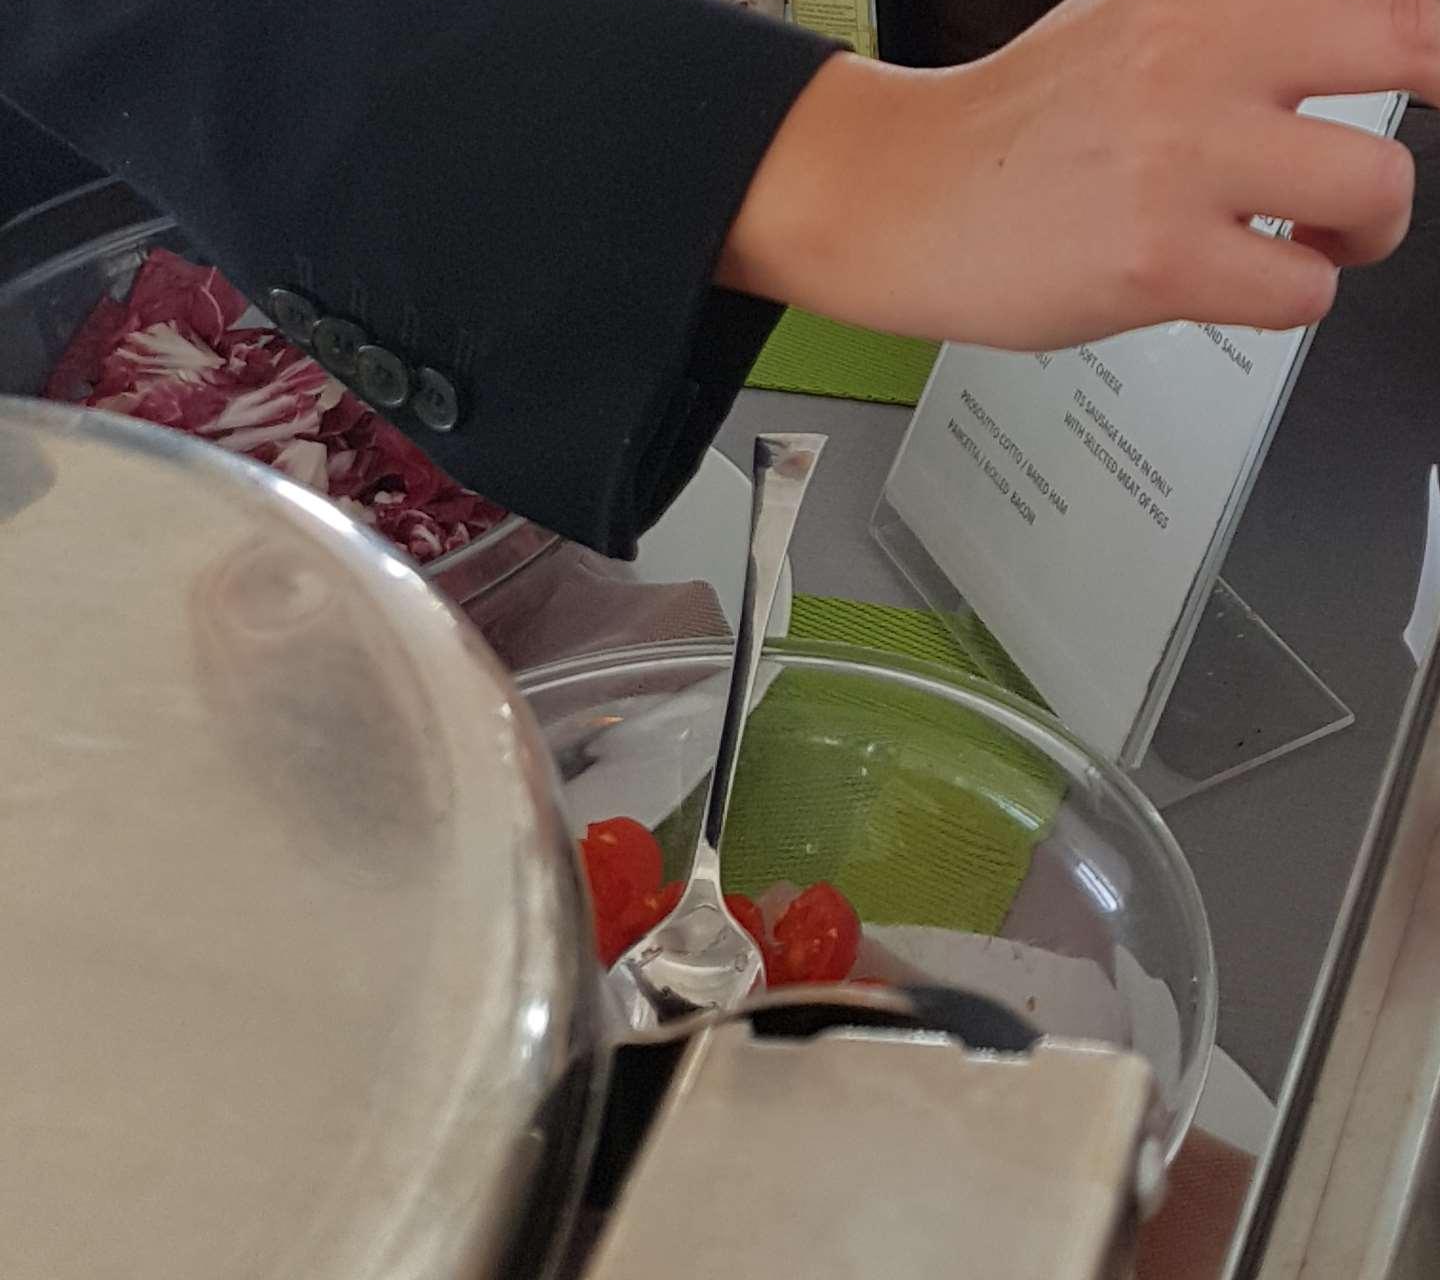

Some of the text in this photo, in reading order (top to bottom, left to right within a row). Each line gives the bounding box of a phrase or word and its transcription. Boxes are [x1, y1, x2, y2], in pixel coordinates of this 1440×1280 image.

[1096, 363, 1122, 396] CHEESE
[1222, 338, 1253, 375] SALAMI
[999, 433, 1023, 464] COTTO
[1026, 463, 1049, 495] BAKED
[1048, 489, 1069, 514] HAM
[1064, 410, 1170, 529] WITH SELECTED MEAT OF PIGS
[1073, 388, 1173, 499] ITS SAUSAGE MADE IN ONLY
[984, 459, 1009, 495] ROLLED
[1010, 491, 1036, 525] BACON
